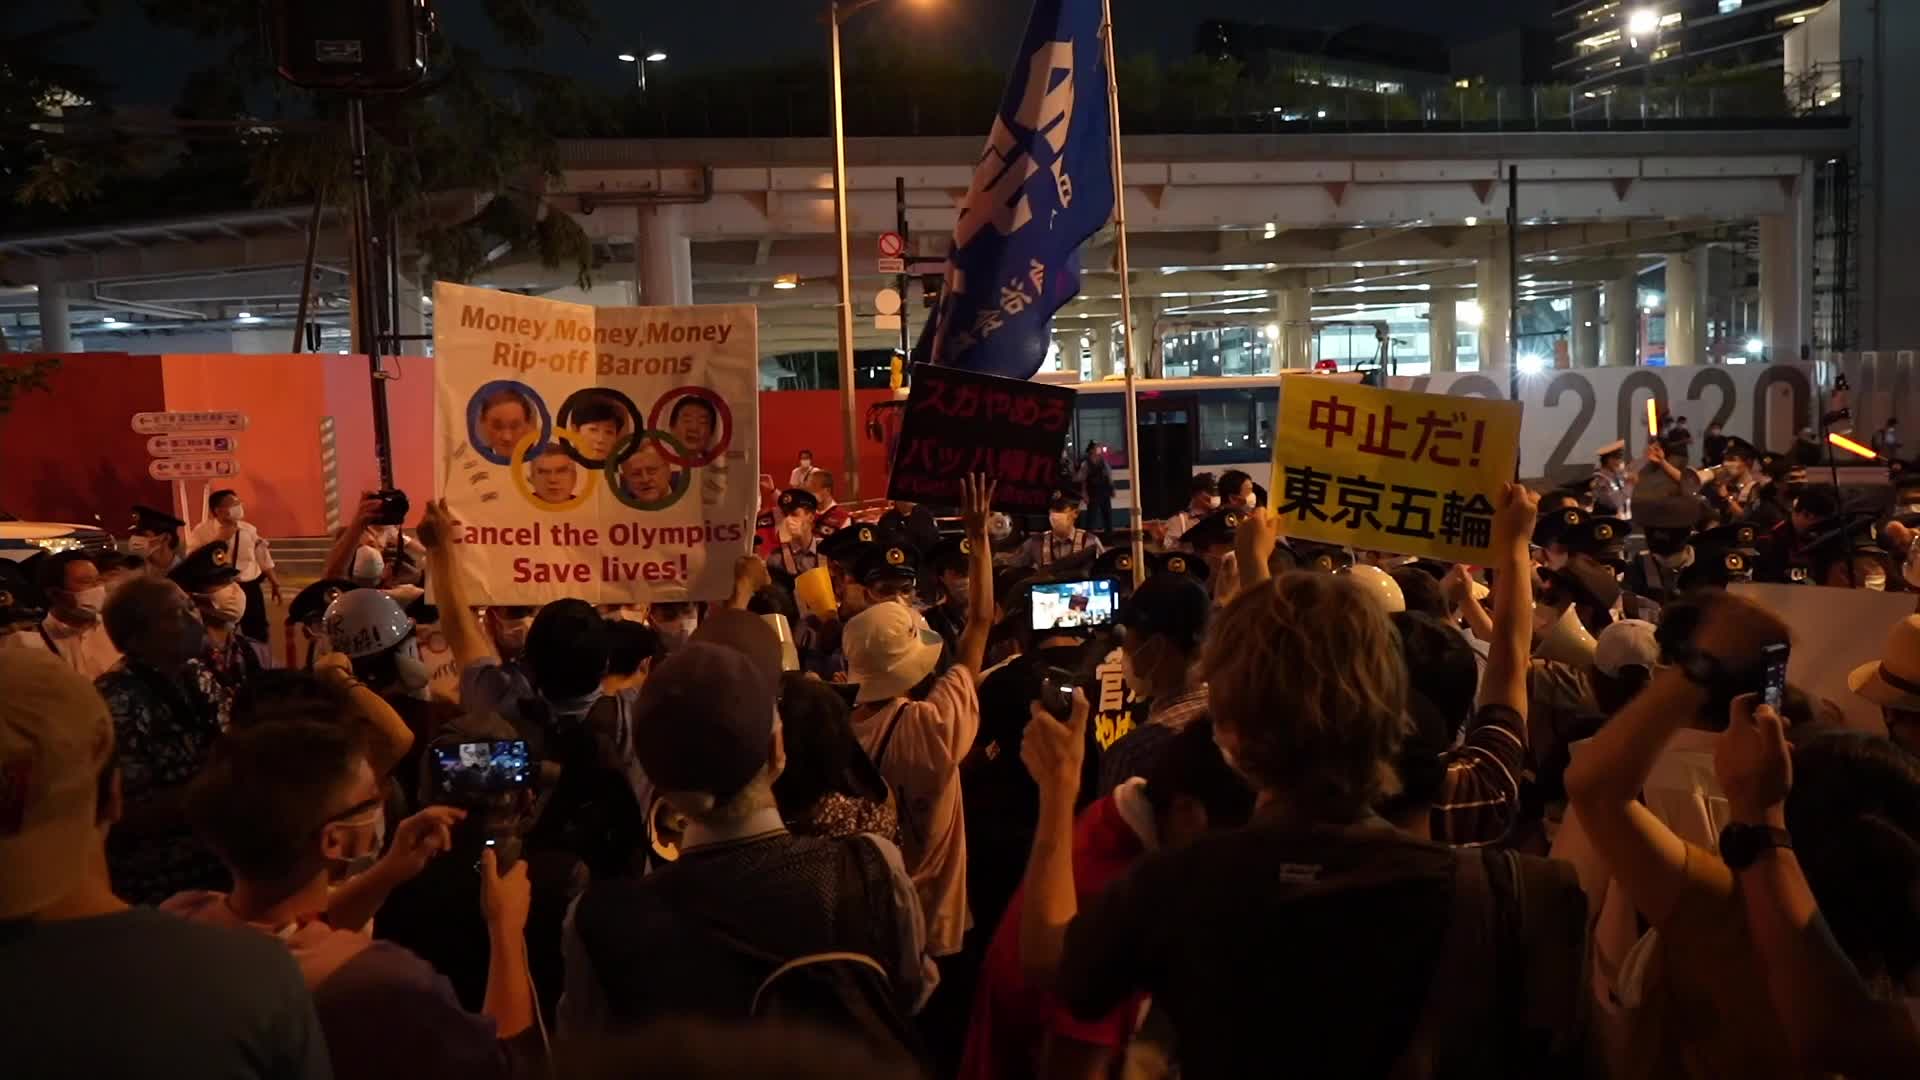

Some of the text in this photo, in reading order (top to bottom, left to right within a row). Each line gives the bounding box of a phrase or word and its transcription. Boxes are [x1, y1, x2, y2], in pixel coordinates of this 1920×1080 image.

[492, 341, 694, 376] Rip-off Barons
[1308, 396, 1486, 467] 中止だ!
[1277, 466, 1496, 549] 東京五輪
[551, 522, 600, 546] the
[513, 554, 688, 583] Save lives!
